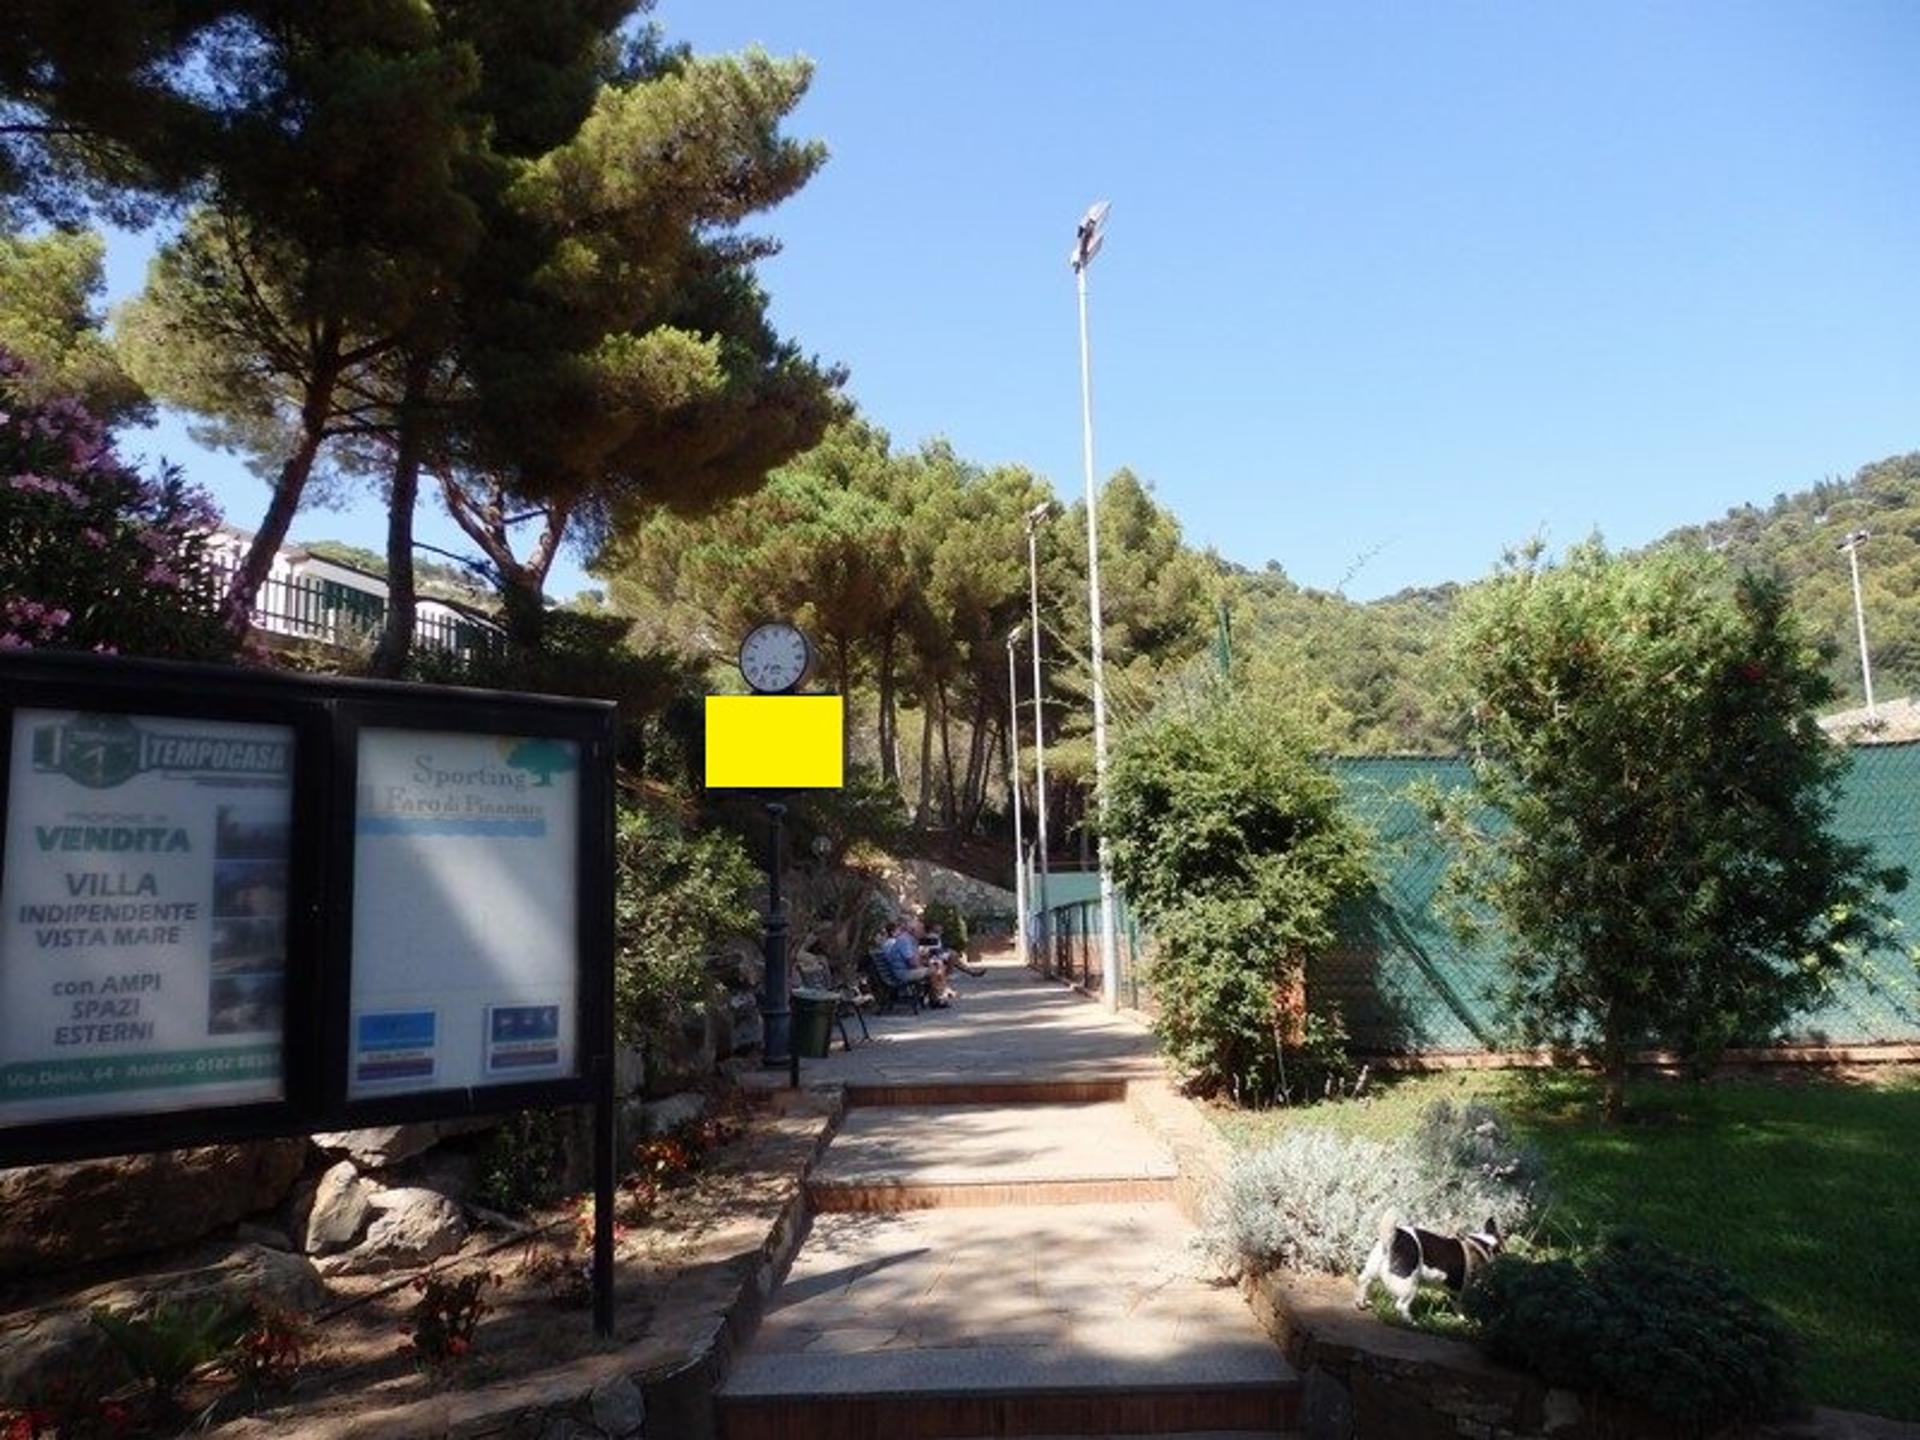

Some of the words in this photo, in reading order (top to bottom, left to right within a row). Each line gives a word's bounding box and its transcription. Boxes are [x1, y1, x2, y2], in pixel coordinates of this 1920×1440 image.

[149, 738, 285, 770] TEMPOCASA
[413, 754, 527, 792] Sporting
[35, 825, 192, 852] VENDITA
[66, 872, 158, 897] VILLA
[19, 902, 198, 924] INDIPENDENTE
[35, 928, 106, 948] VISTA
[113, 926, 180, 946] MARE
[52, 980, 95, 996] con
[100, 973, 162, 994] AMPI
[71, 999, 140, 1020] SPAZI
[53, 1022, 155, 1045] ESTERNI
